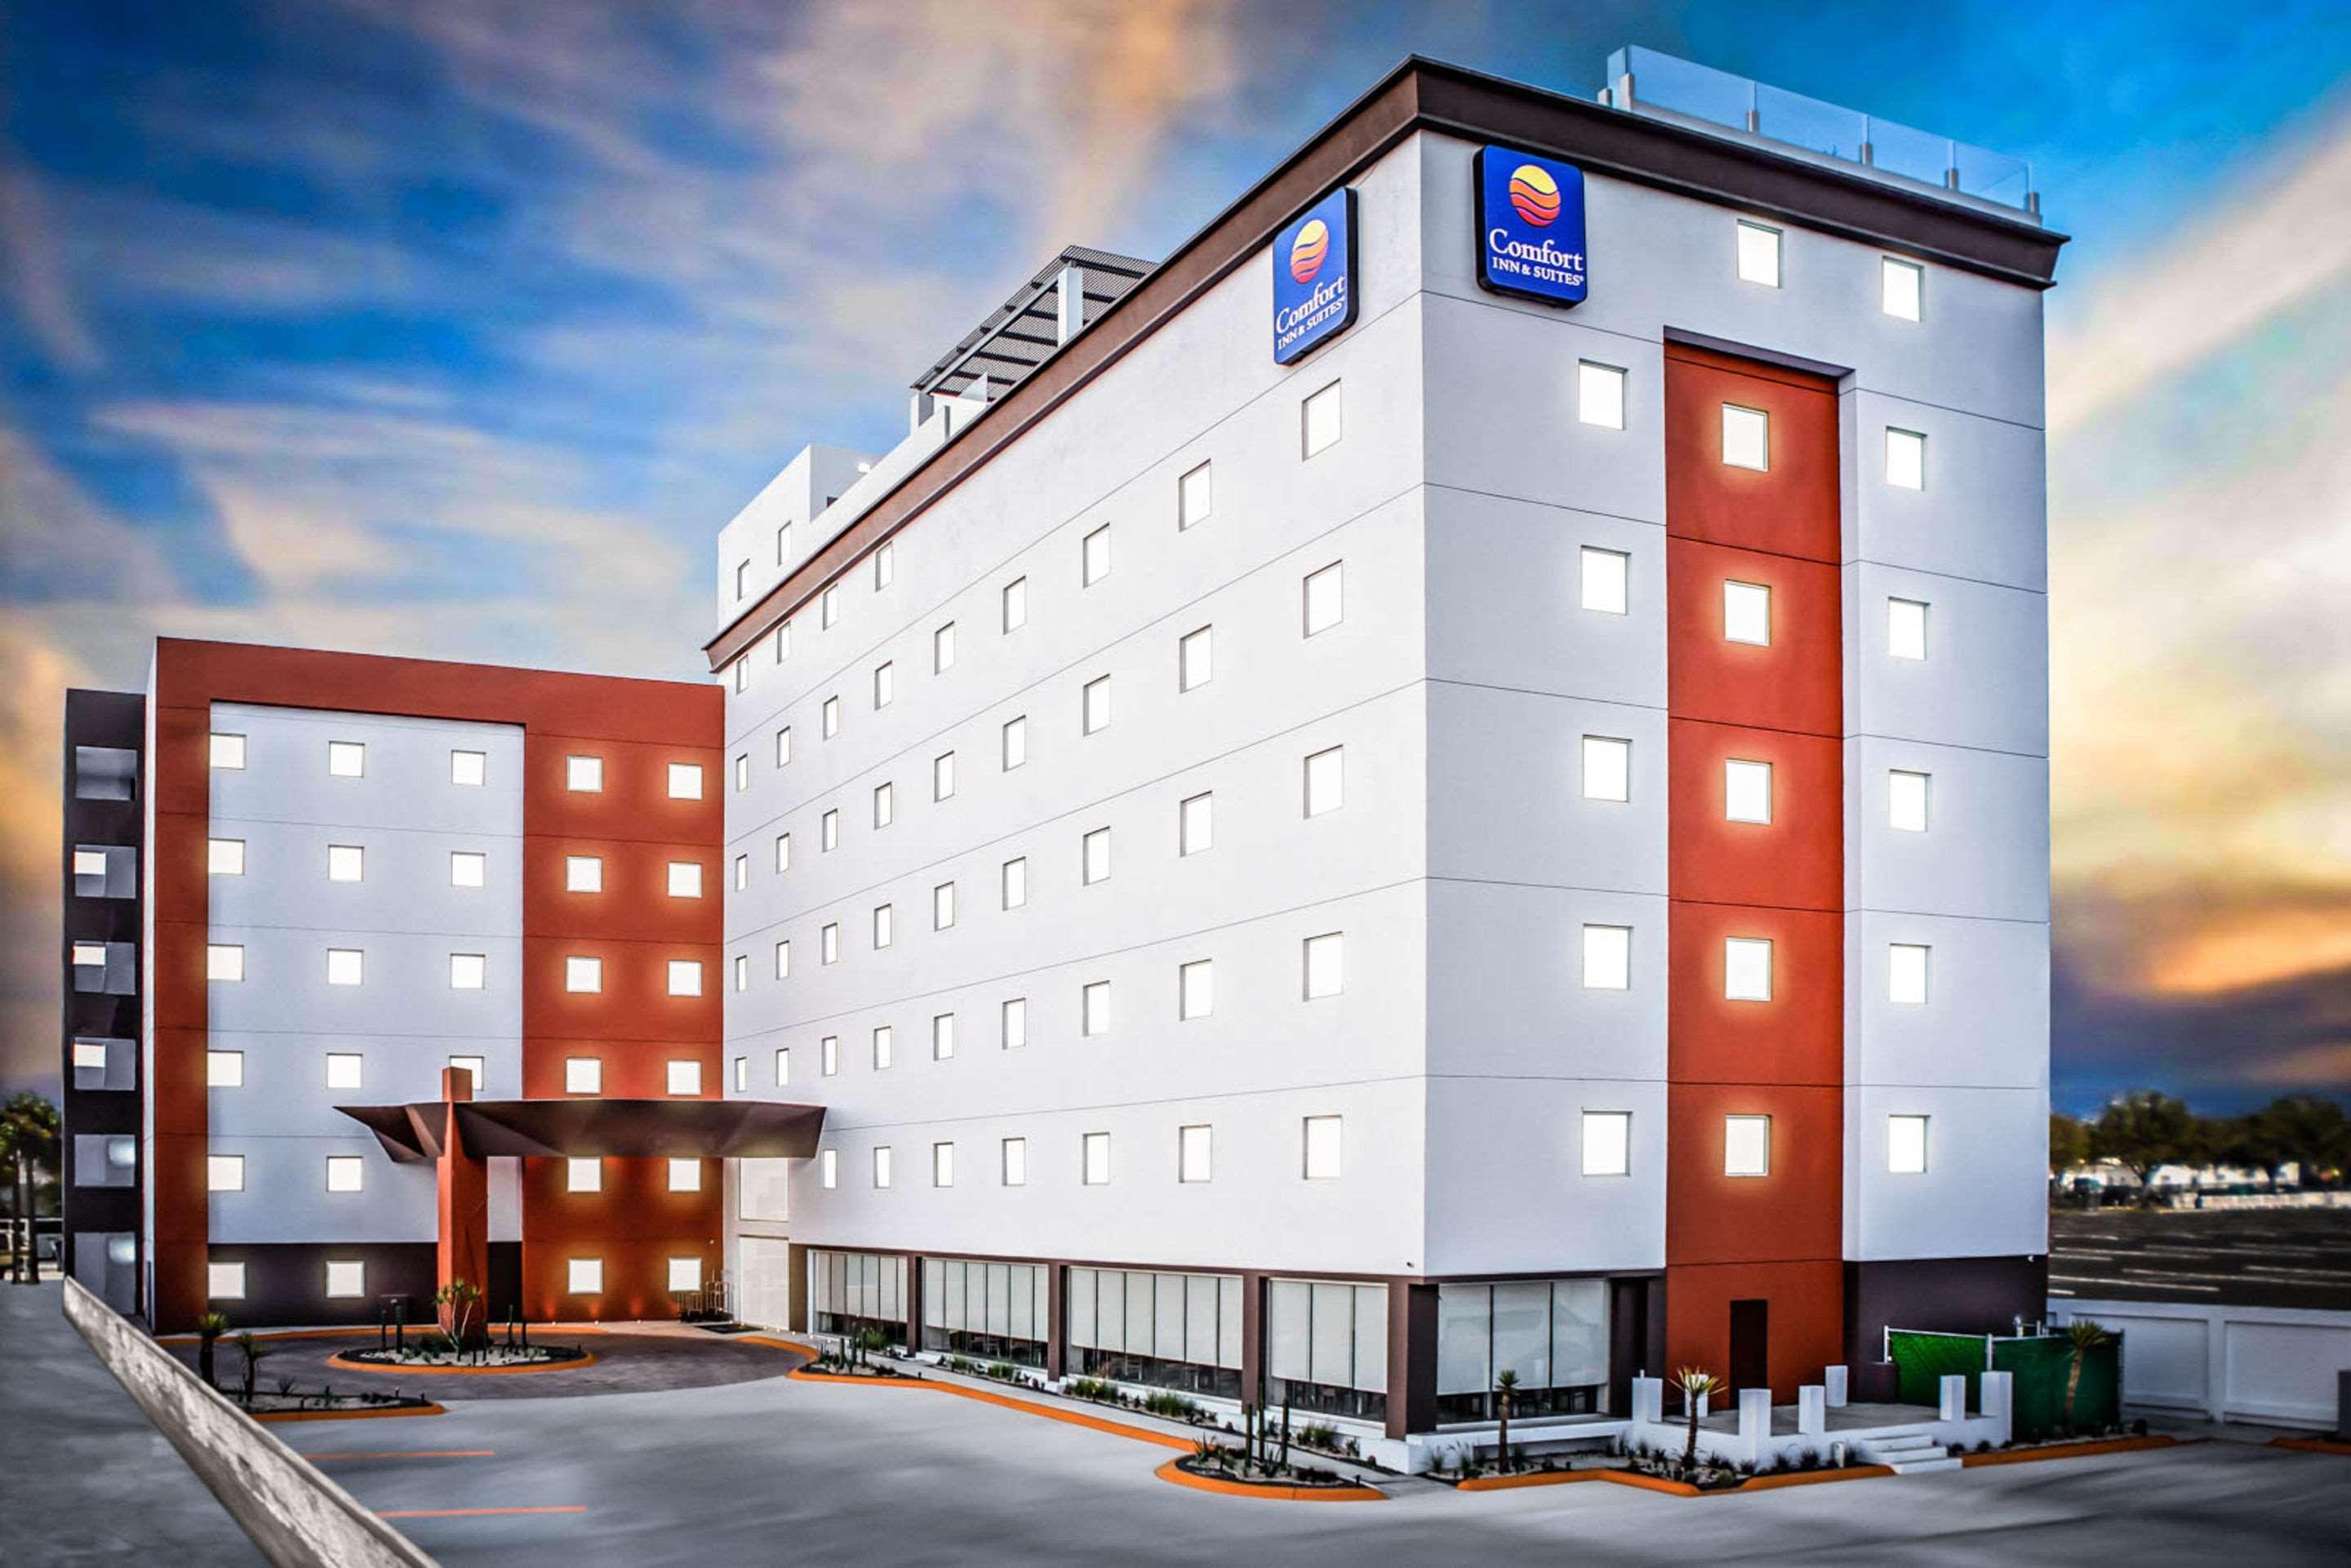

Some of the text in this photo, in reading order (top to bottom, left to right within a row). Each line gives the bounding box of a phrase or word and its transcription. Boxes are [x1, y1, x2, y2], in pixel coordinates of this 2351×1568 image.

[1488, 228, 1584, 271] Comfort
[1492, 256, 1520, 273] INN
[1522, 264, 1531, 276] &
[1276, 275, 1345, 334] Comfort
[1278, 327, 1299, 350] INN
